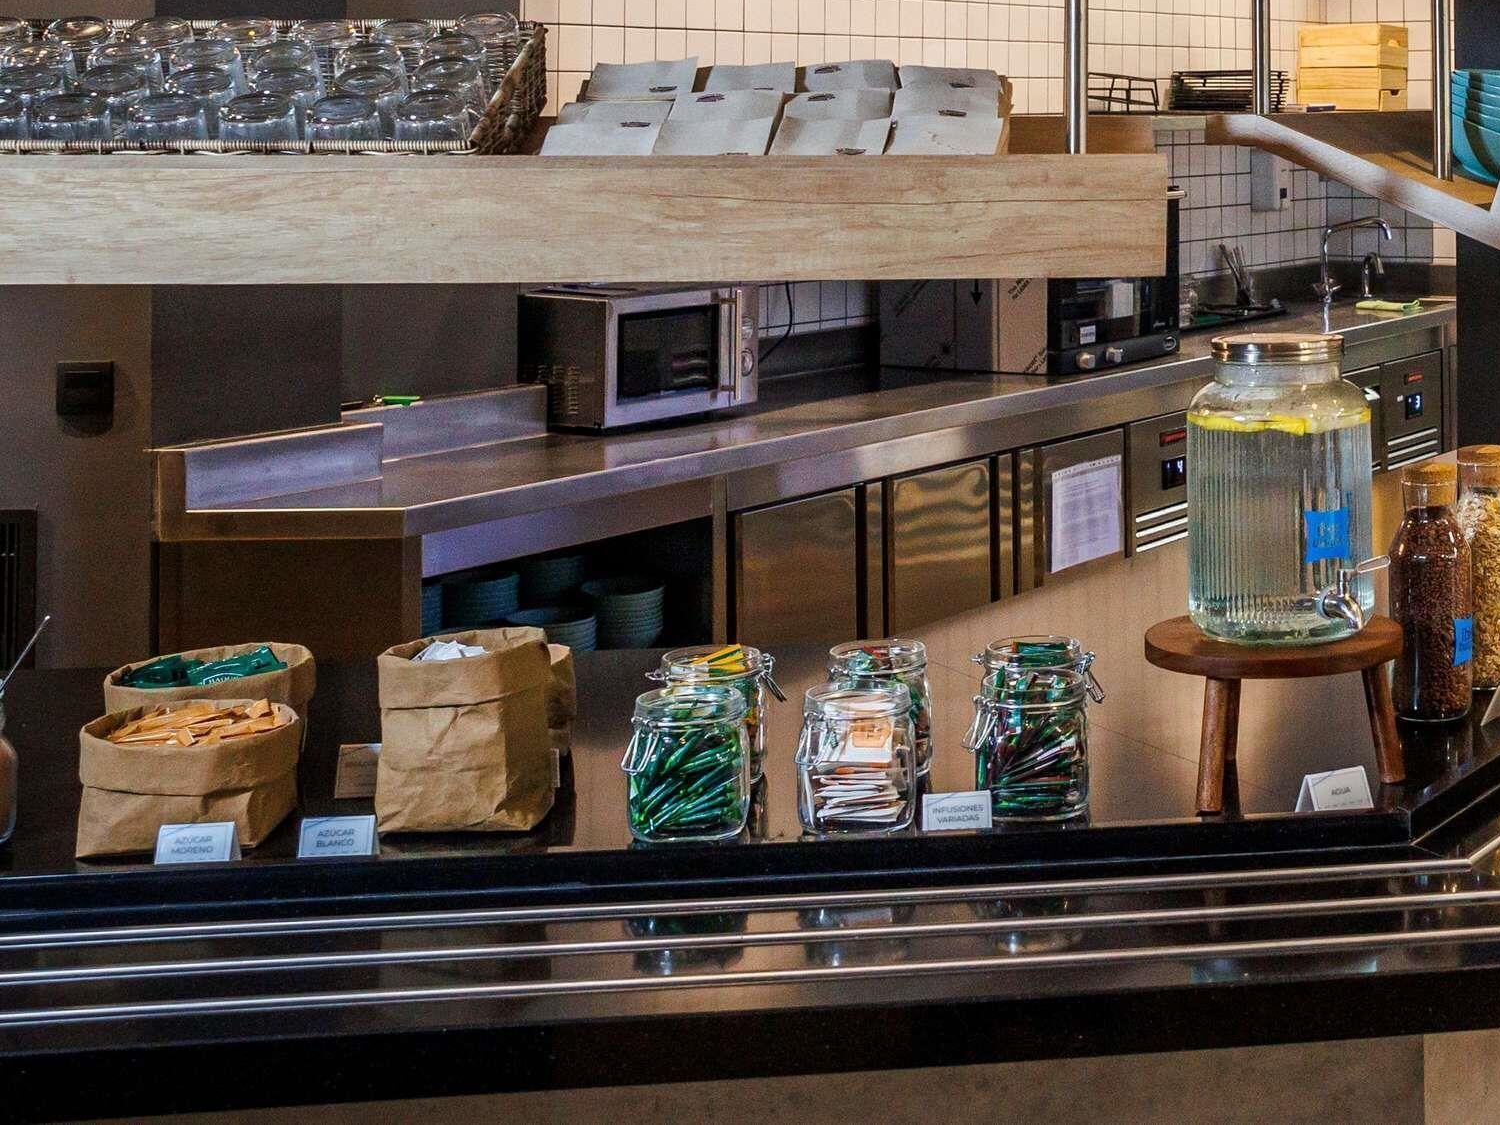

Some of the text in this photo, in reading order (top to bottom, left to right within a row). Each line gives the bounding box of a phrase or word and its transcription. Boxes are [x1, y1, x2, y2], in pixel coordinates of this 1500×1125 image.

[932, 804, 984, 814] INFUSIONES
[937, 814, 980, 824] VARIADAS
[315, 838, 355, 848] BLANCO
[170, 845, 214, 855] MORENO
